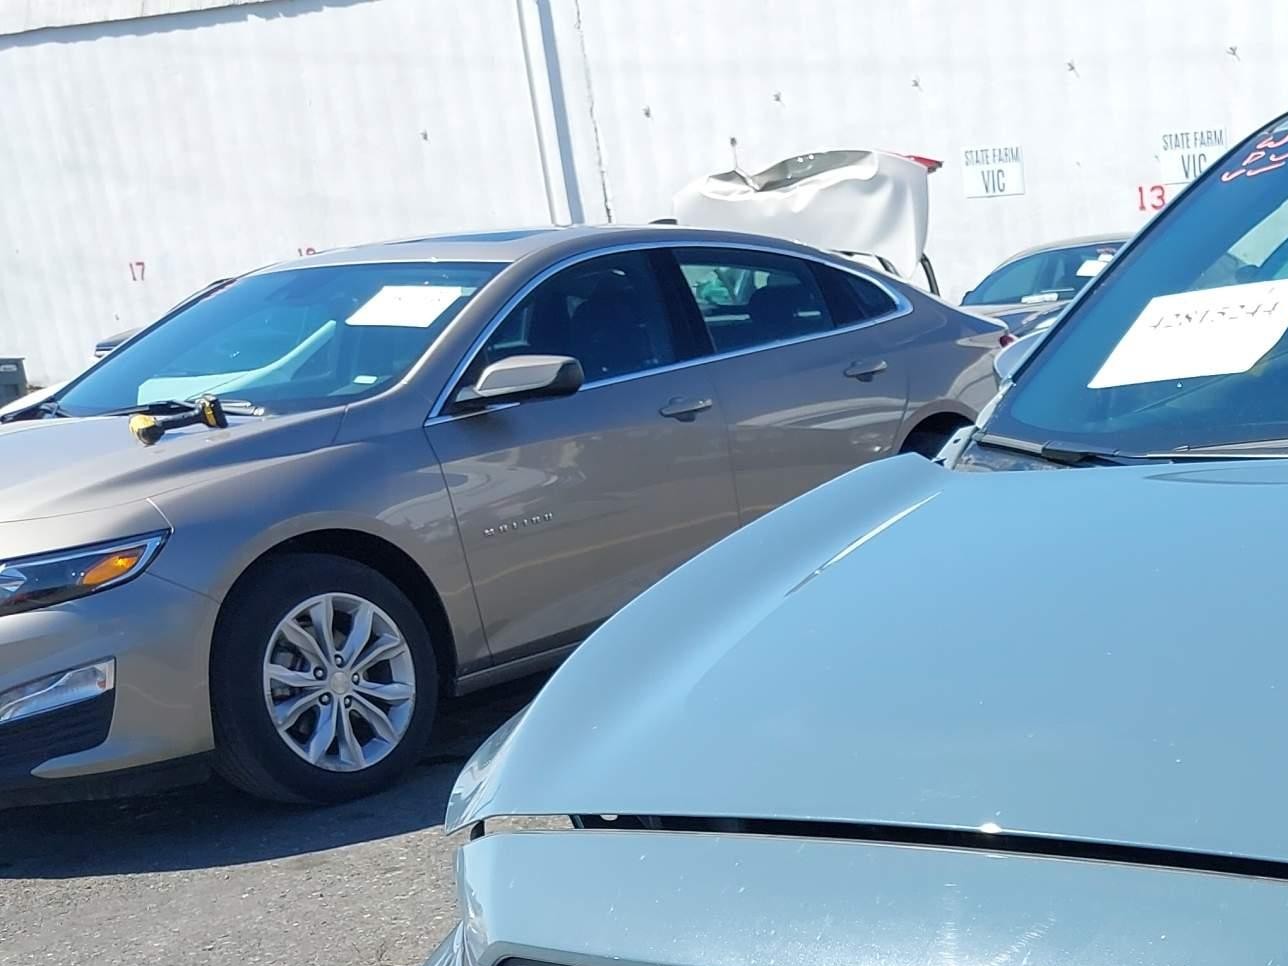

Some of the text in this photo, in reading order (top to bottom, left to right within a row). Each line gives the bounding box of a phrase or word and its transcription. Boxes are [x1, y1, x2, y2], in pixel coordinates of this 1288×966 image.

[1162, 129, 1224, 151] STATE FARM
[964, 146, 1020, 167] STATE FARM
[1181, 153, 1207, 179] VIC
[981, 168, 1006, 194] VIC
[1138, 185, 1166, 211] 13
[129, 261, 146, 282] 17
